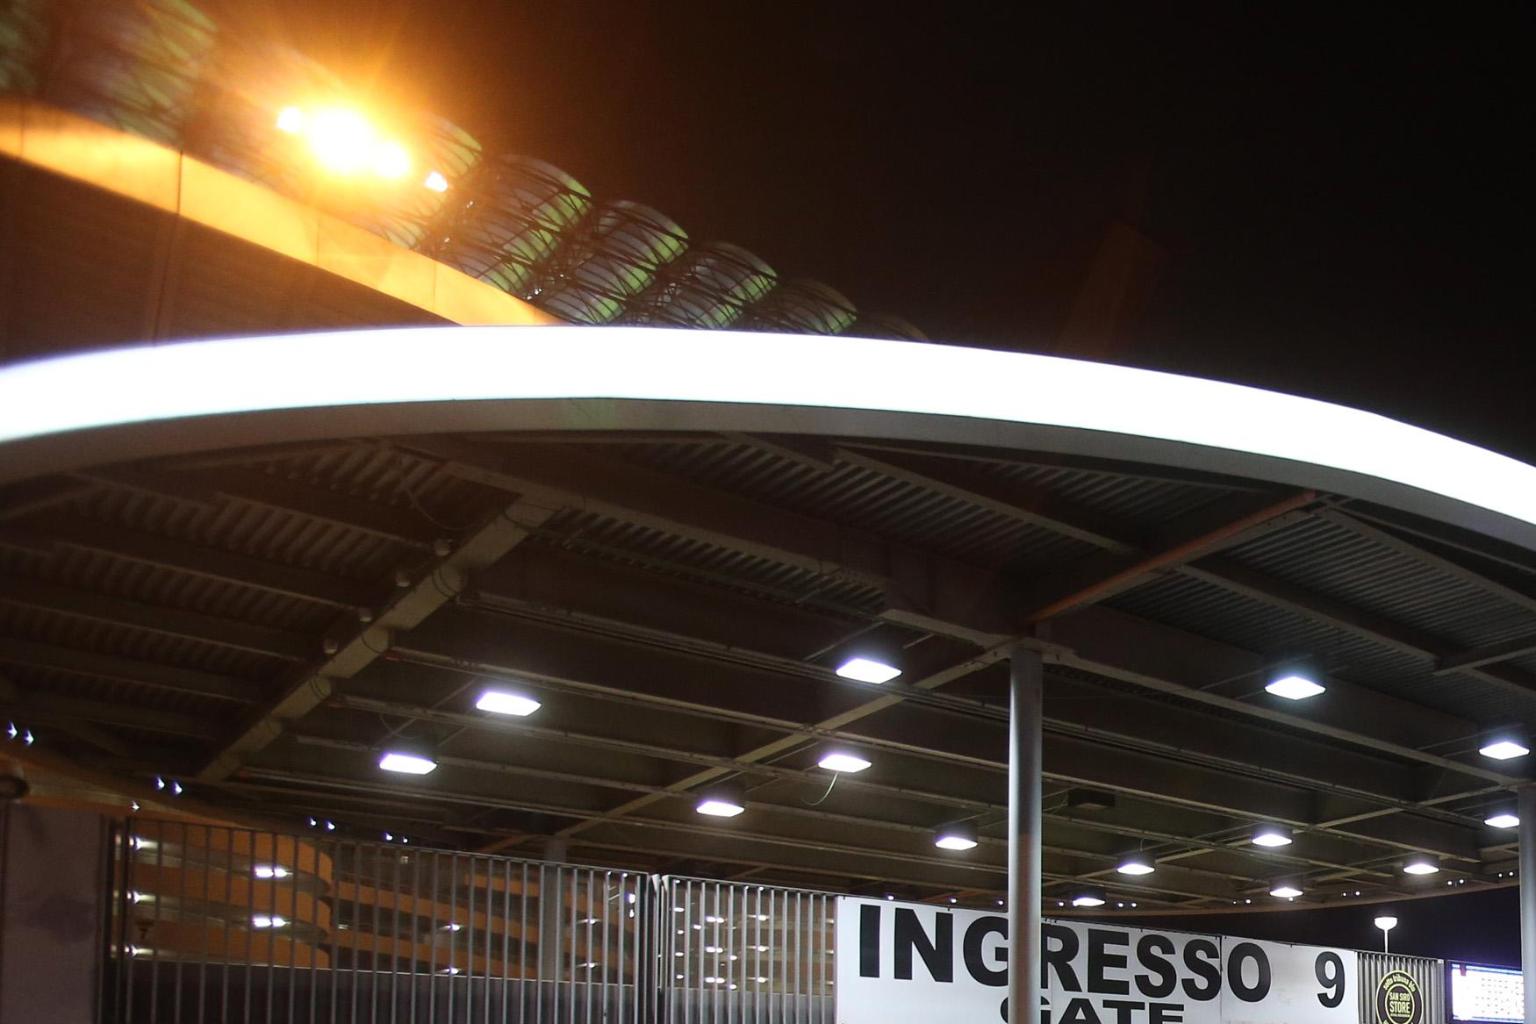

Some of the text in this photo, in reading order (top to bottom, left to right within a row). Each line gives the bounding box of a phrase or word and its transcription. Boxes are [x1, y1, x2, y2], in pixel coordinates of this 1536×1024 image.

[859, 904, 1346, 1008] INGRESSO 9
[1389, 992, 1410, 1001] SAN SIRO
[1389, 1001, 1410, 1013] STORE
